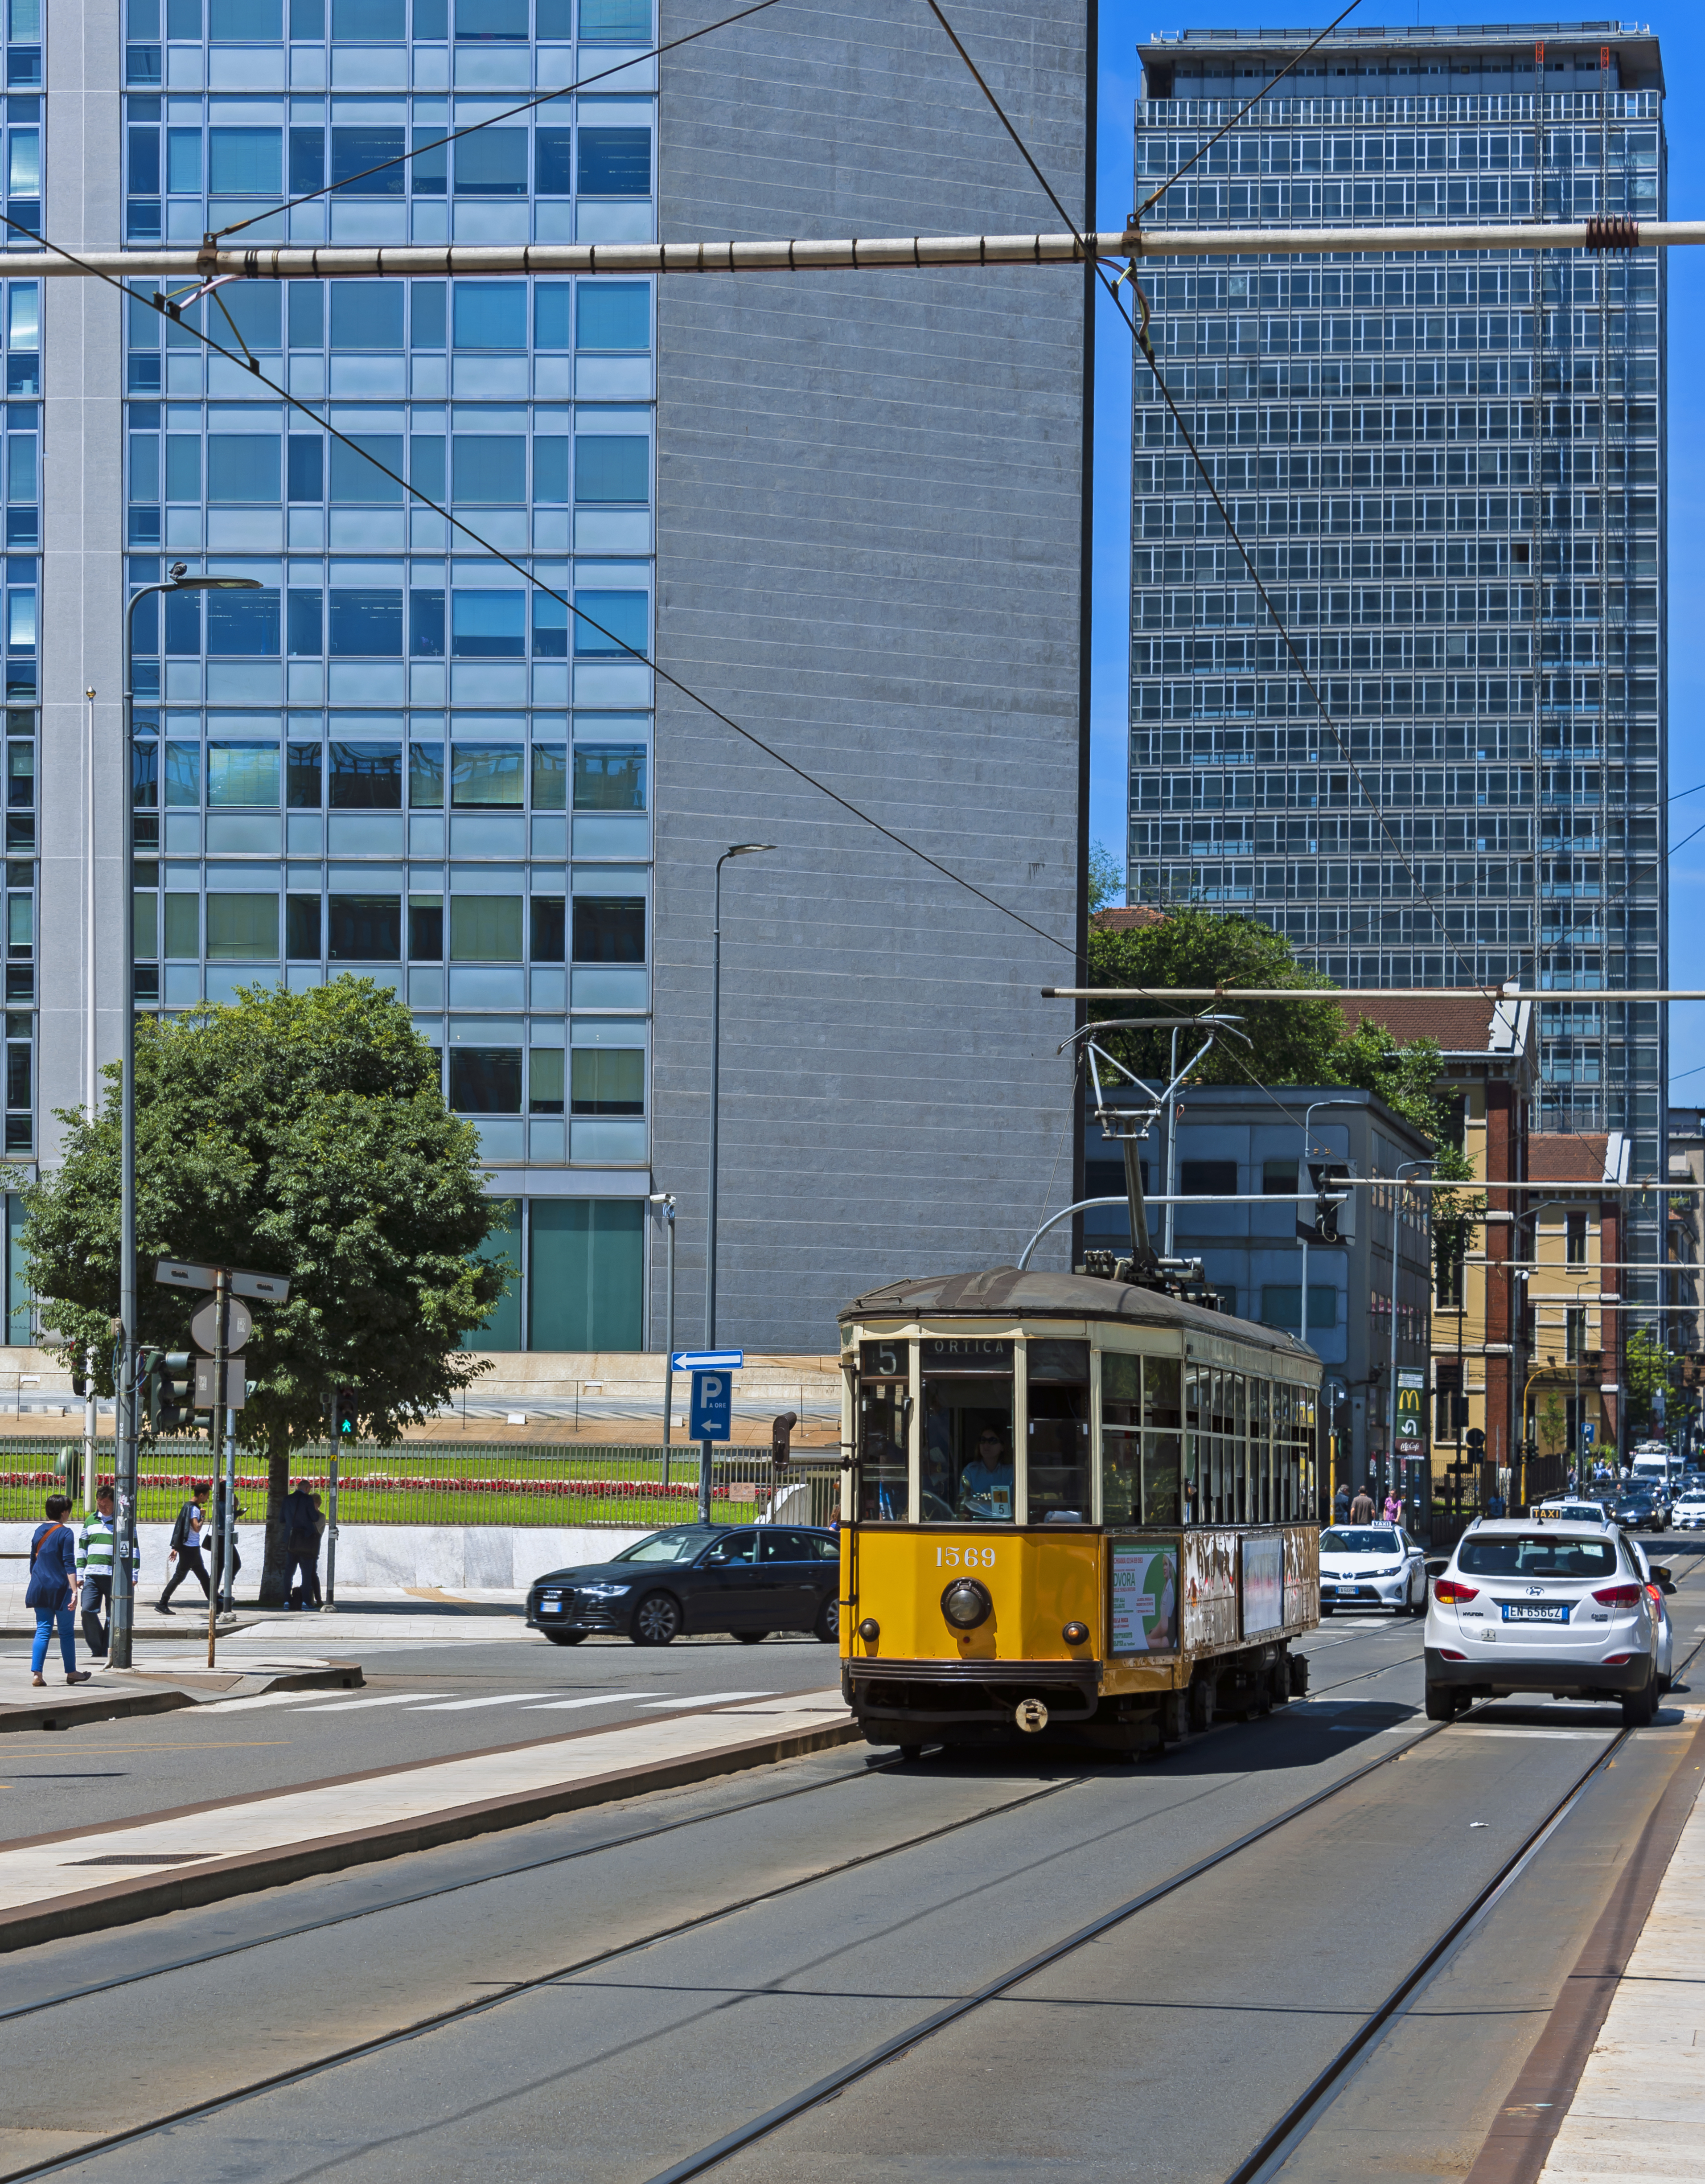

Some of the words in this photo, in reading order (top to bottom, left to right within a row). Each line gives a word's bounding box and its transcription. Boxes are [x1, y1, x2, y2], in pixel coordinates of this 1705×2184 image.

[934, 1340, 1003, 1353] ORTICA
[879, 1340, 896, 1375] 5
[701, 1376, 722, 1408] P
[998, 1504, 1004, 1514] 5
[1533, 1509, 1559, 1518] TAXI
[936, 1547, 996, 1568] 1569
[1511, 1605, 1523, 1617] EN
[1528, 1606, 1561, 1617] 656GZ
